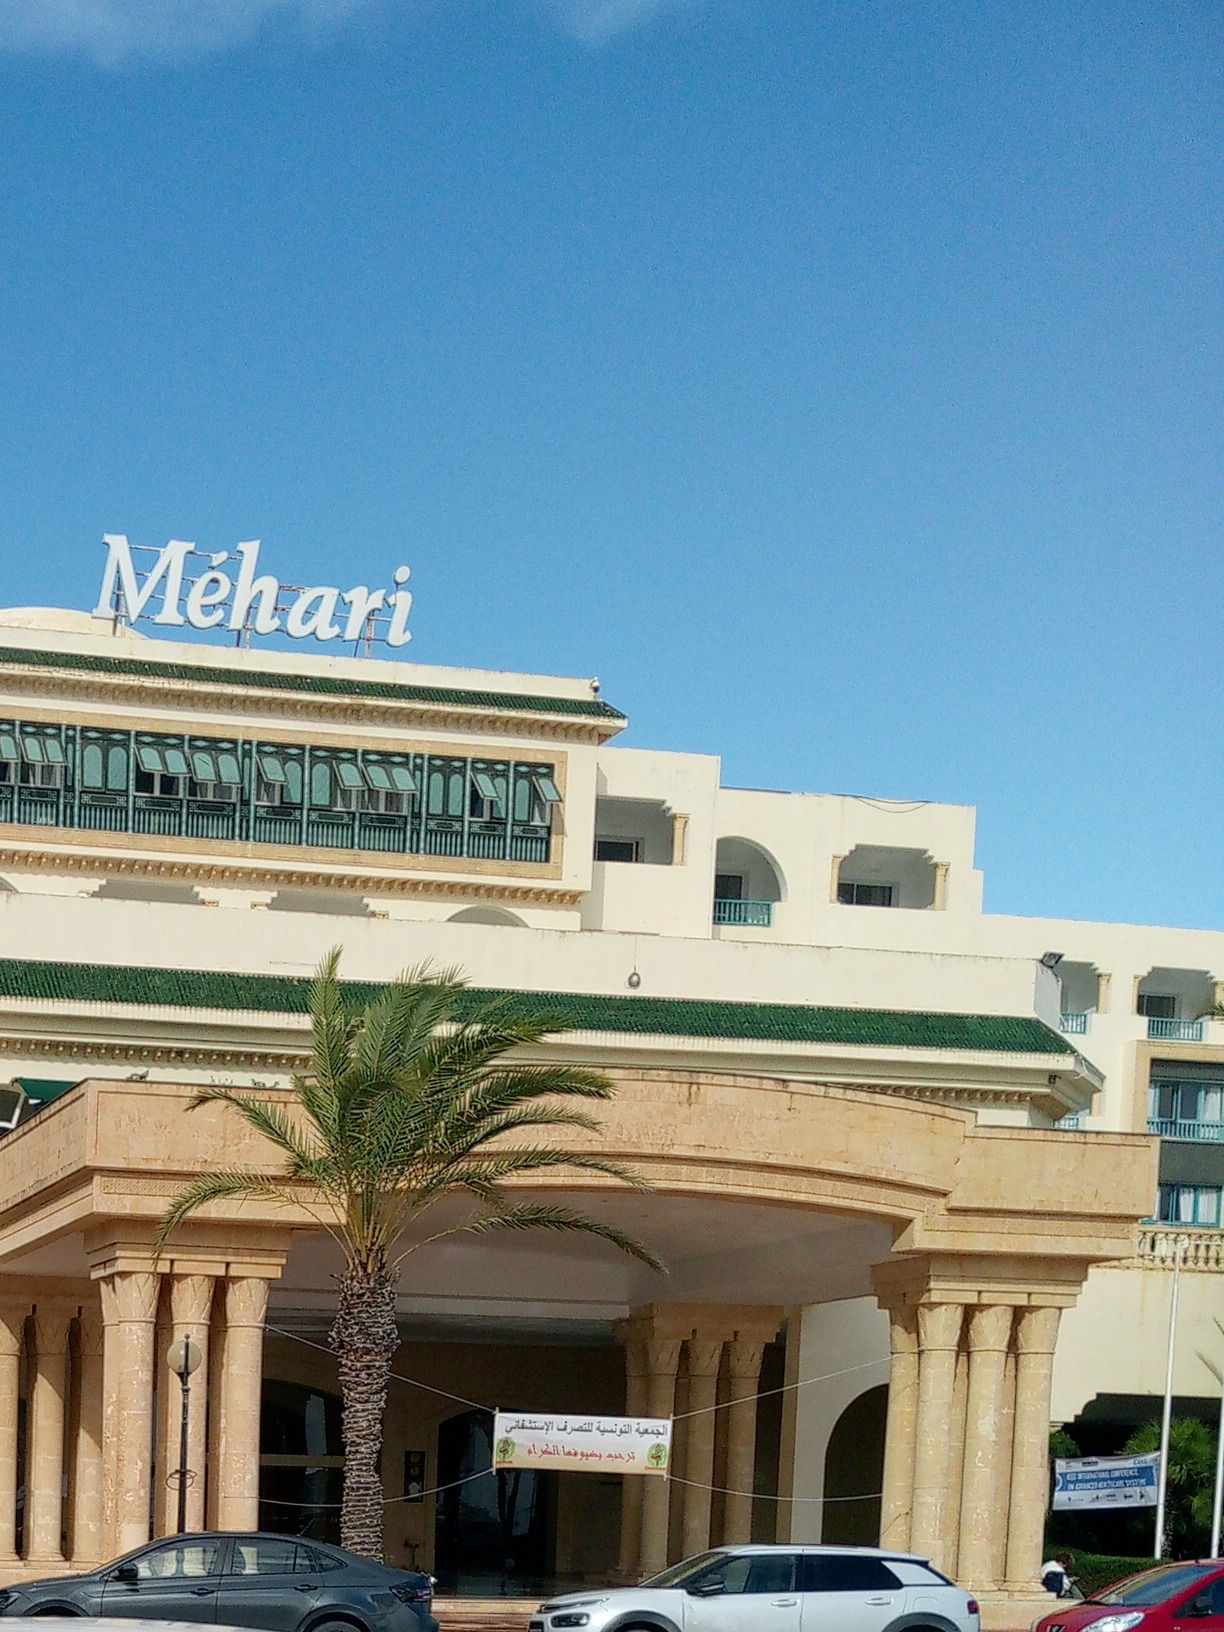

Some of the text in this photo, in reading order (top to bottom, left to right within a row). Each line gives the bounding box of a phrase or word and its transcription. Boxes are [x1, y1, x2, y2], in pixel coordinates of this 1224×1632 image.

[91, 532, 413, 647] Méhari
[557, 1421, 593, 1434] للتصرف
[596, 1421, 632, 1437] التونسية
[636, 1422, 668, 1438] الجمعية
[527, 1443, 635, 1463] ترحب بضيوفها الكرام
